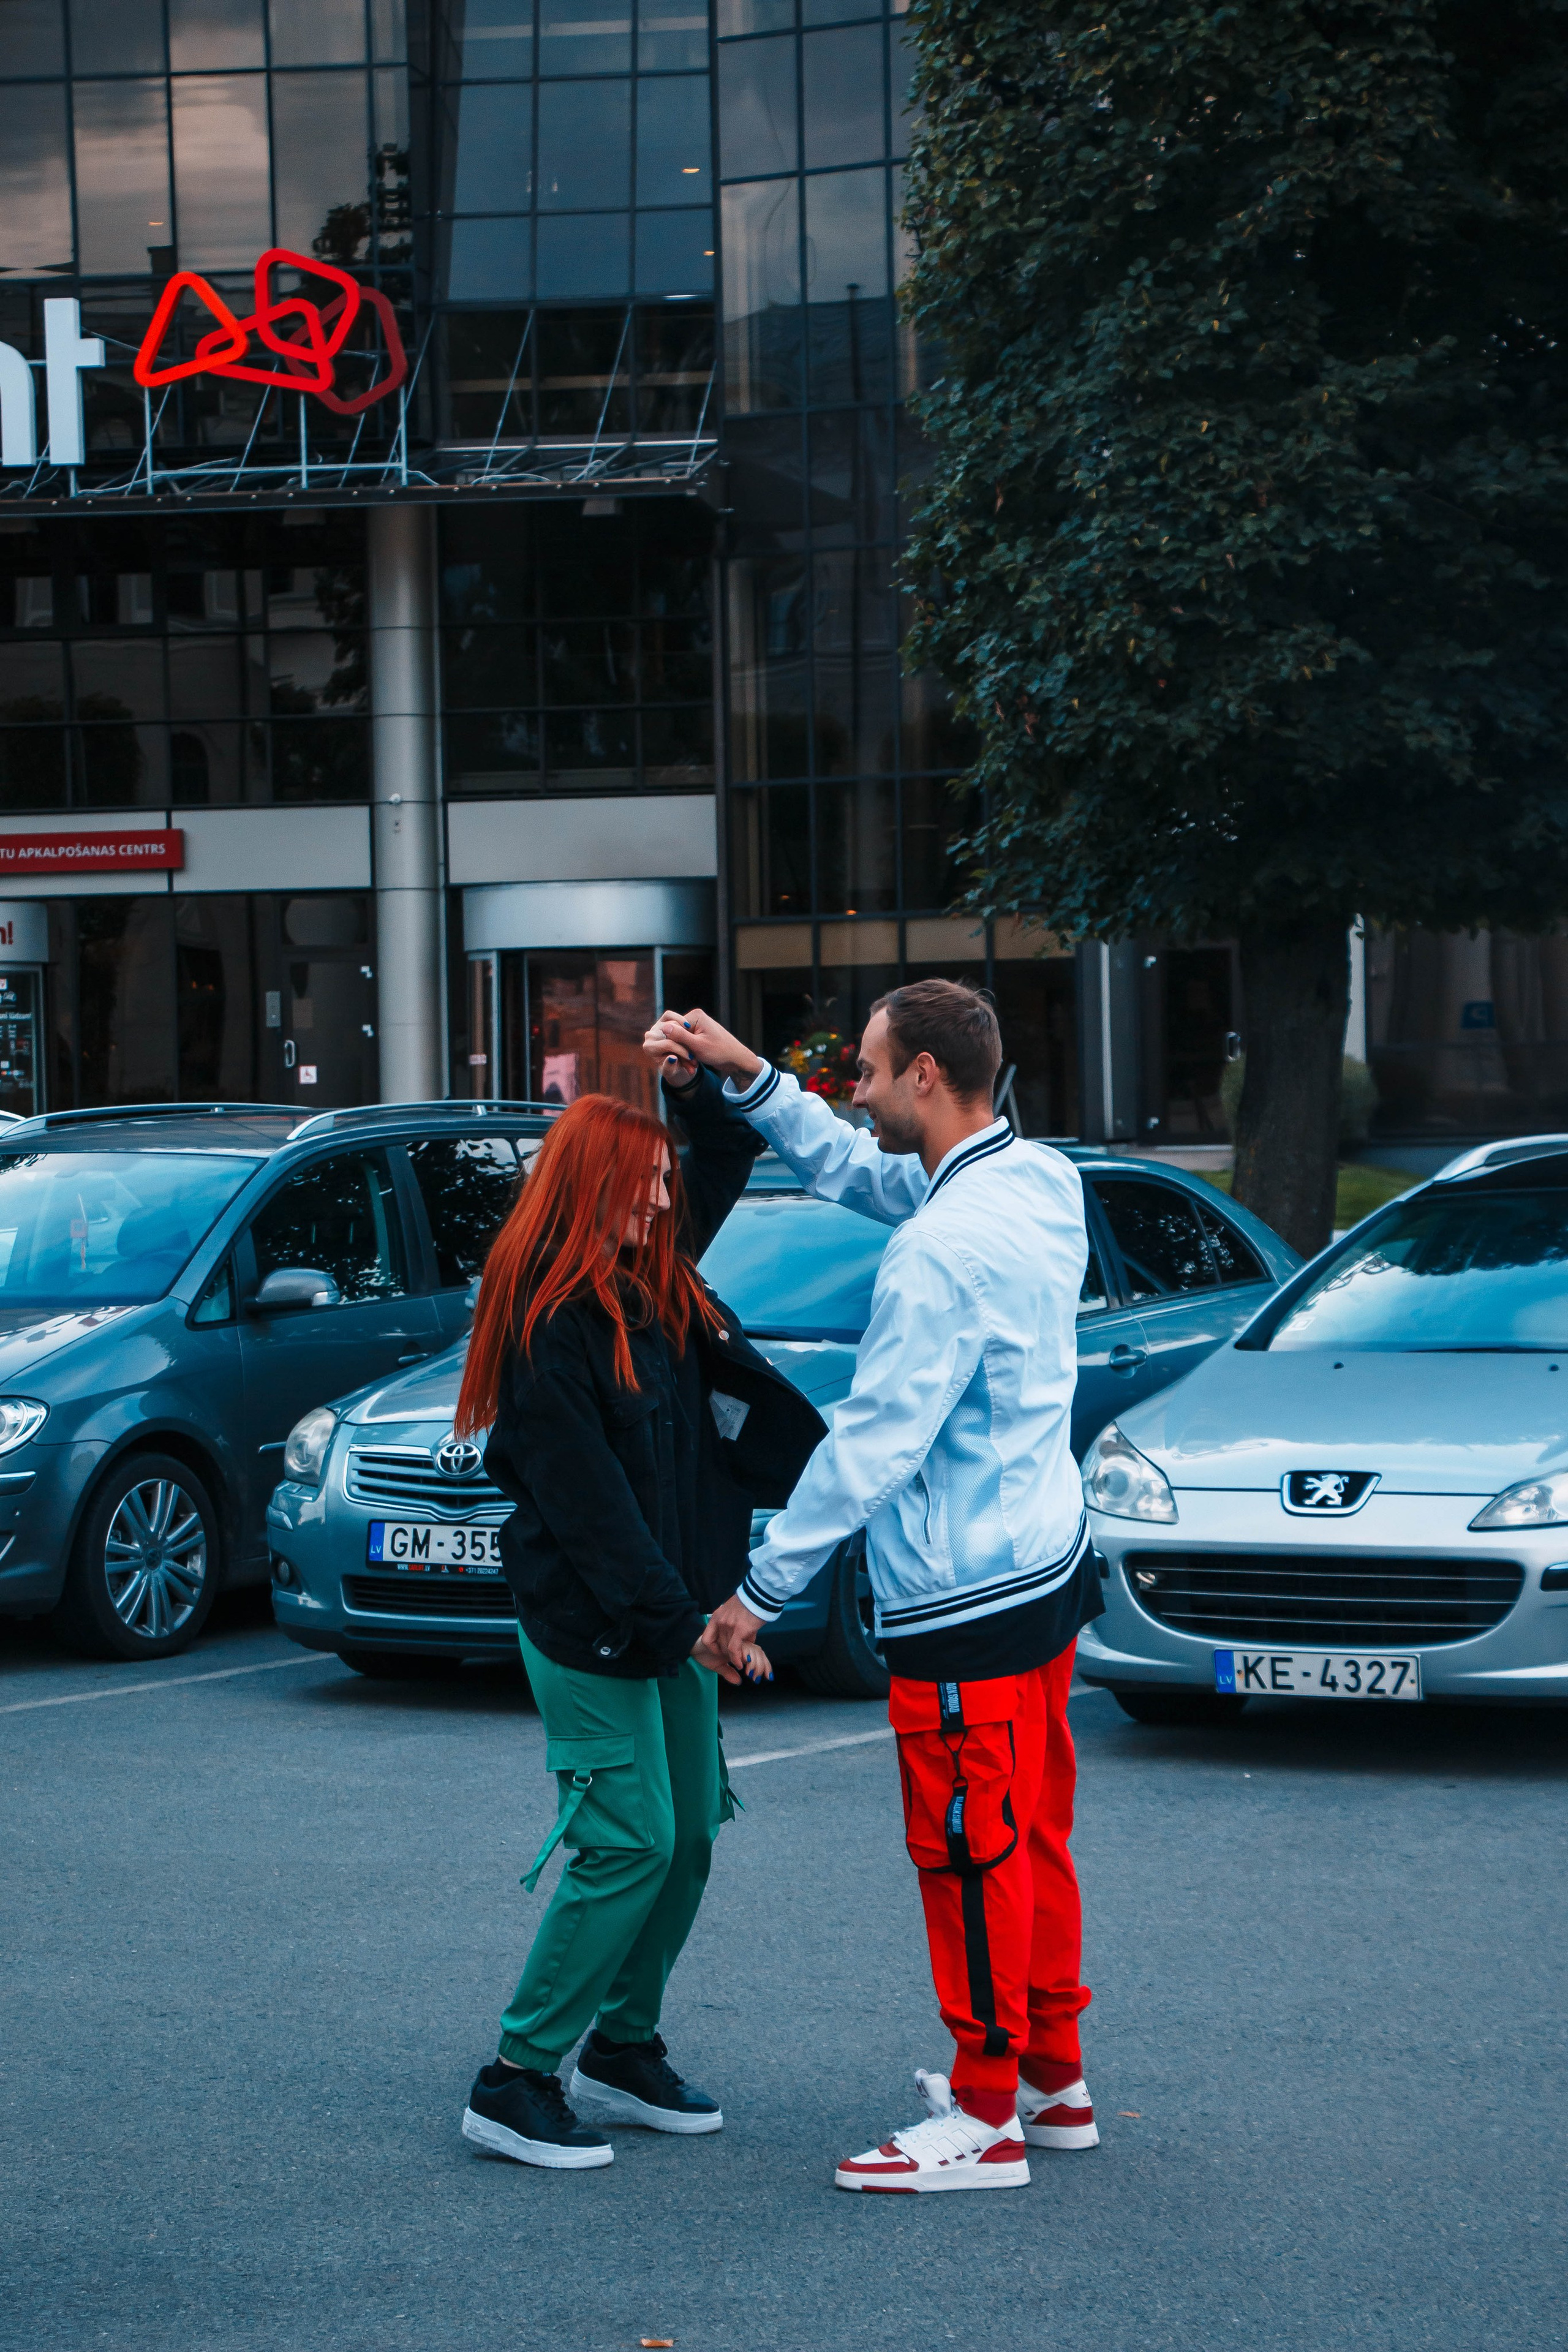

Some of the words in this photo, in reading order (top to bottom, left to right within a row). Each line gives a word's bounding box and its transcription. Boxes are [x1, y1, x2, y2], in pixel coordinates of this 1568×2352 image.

[18, 843, 116, 858] APKALPOŠANAS
[119, 843, 166, 855] CENTRS
[371, 1545, 382, 1554] LV
[1219, 1676, 1232, 1684] LV
[1243, 1656, 1411, 1695] KE-4327
[948, 1694, 960, 1713] SQUAD
